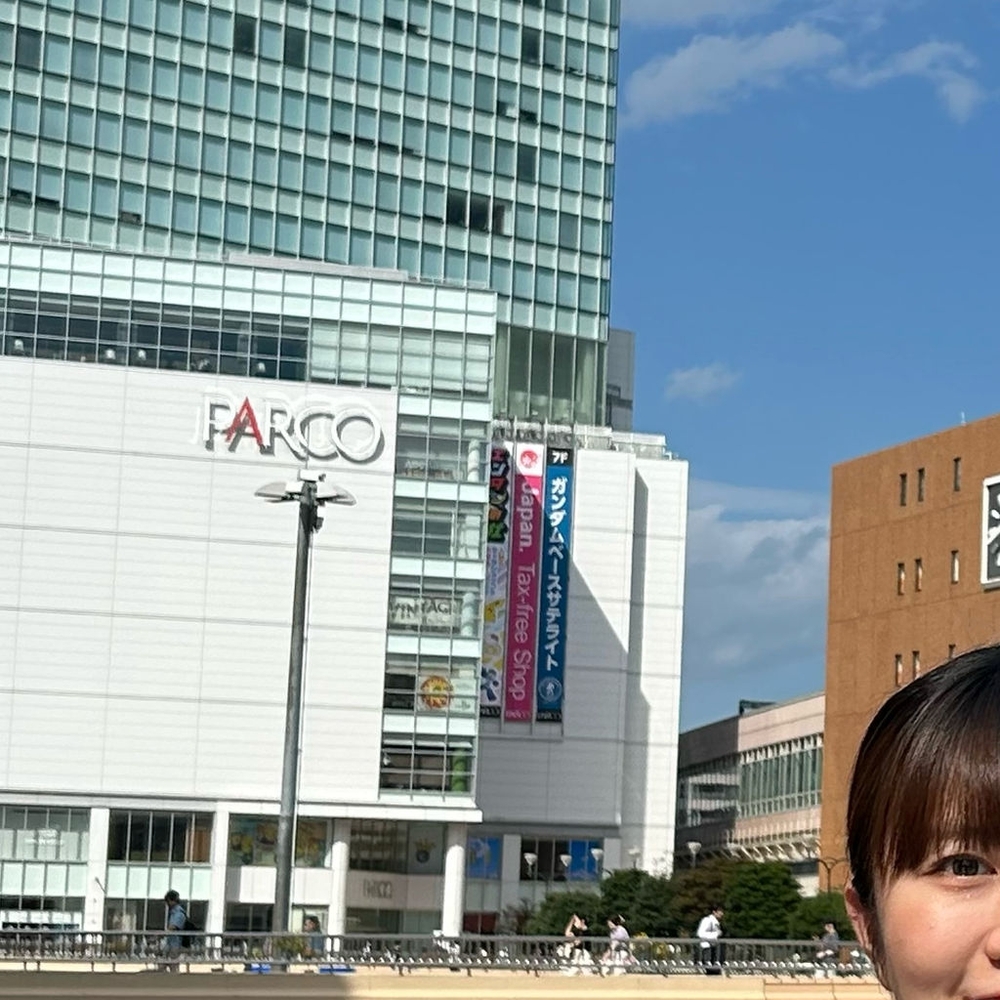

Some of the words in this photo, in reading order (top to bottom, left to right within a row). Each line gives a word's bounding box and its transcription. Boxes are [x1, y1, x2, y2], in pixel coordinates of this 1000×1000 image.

[203, 387, 384, 463] PARCO
[552, 451, 569, 464] 7F
[513, 562, 536, 643] Tax-free
[545, 476, 569, 671] ガンダムベースサテライト
[508, 648, 532, 701] Shop
